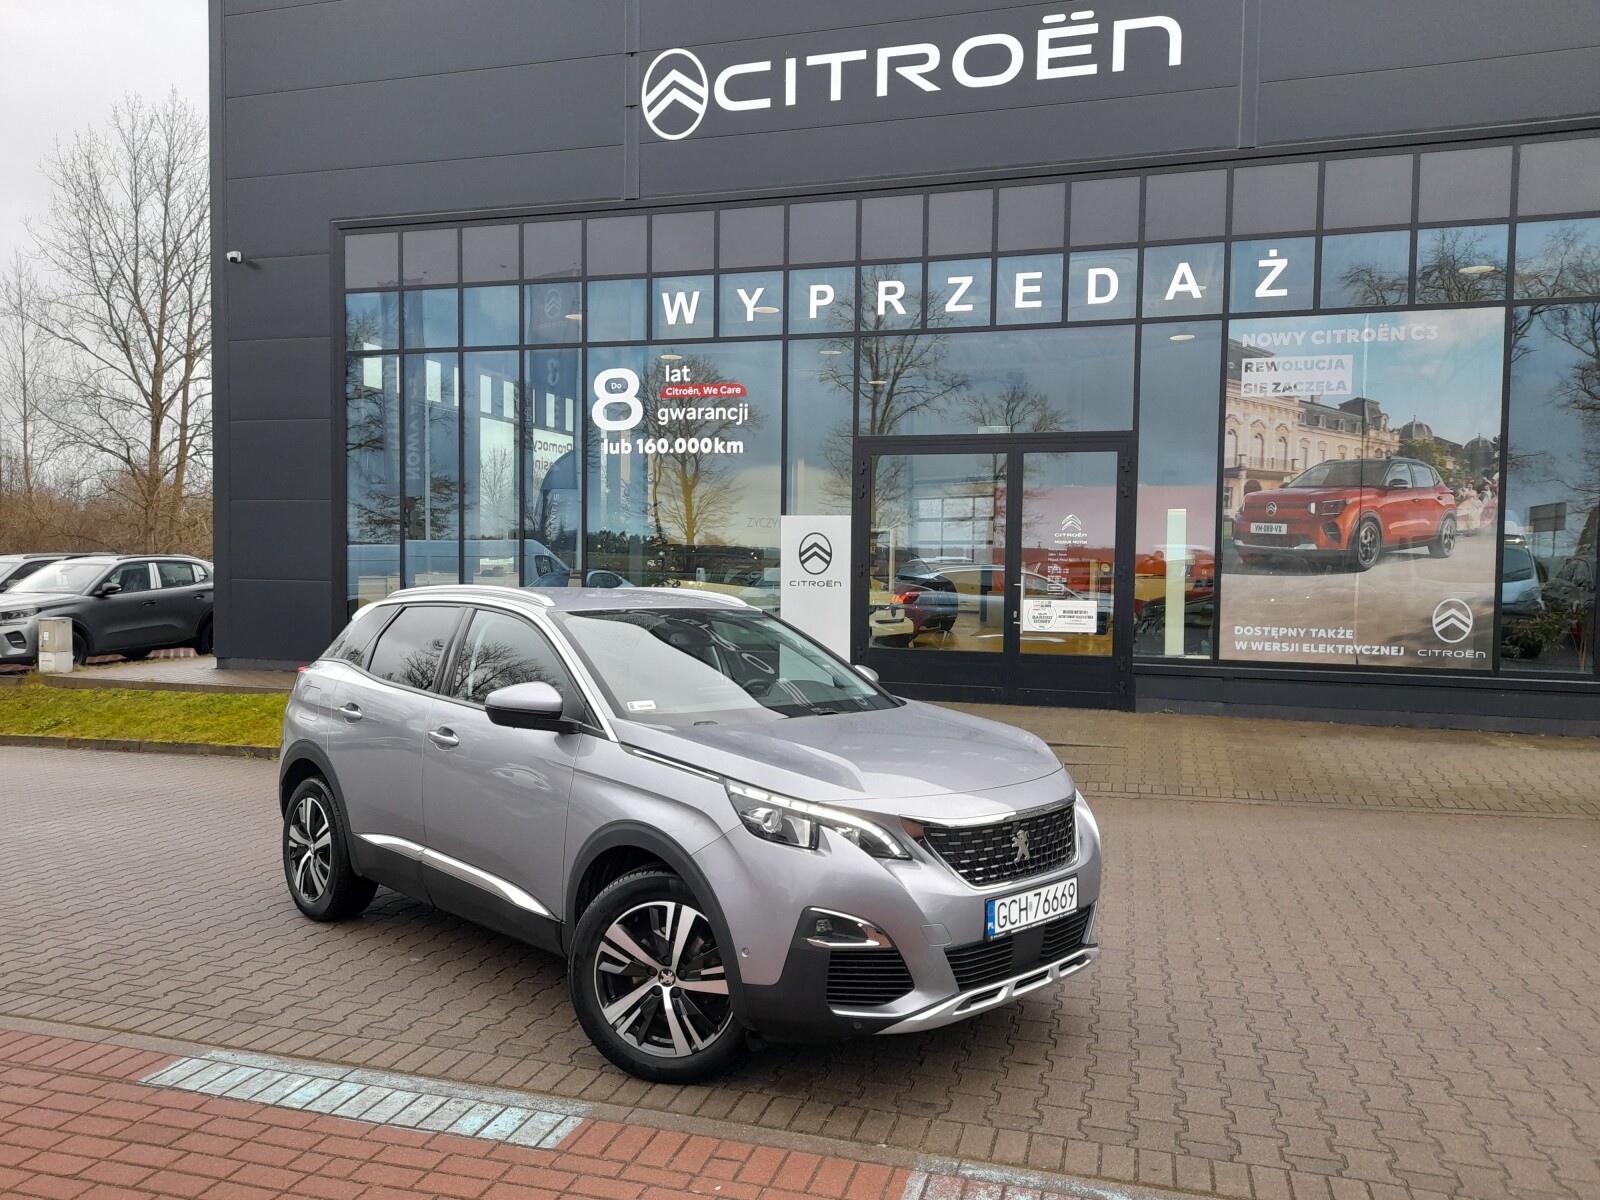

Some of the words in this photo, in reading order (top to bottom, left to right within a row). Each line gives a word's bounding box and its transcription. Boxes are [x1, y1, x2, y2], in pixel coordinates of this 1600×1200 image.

[714, 10, 1182, 111] CITROËN
[1242, 330, 1305, 348] NOWY
[1311, 323, 1405, 345] CITROËN
[1410, 325, 1439, 341] C3
[665, 365, 690, 382] lat
[1244, 359, 1345, 373] REWOLUCJA
[611, 382, 622, 390] Do
[665, 386, 702, 396] Citroën,
[703, 386, 719, 395] We
[720, 386, 741, 395] Care
[591, 368, 644, 431] 8
[657, 403, 749, 426] gwarancji
[602, 438, 632, 455] lub
[789, 579, 842, 588] CITROËN
[1234, 625, 1306, 639] DOSTĘPNY
[1309, 626, 1354, 639] TAKŻE
[1235, 640, 1248, 650] W
[1250, 641, 1300, 653] WERSJI
[1302, 643, 1405, 657] ELEKTRYCZNEJ
[1417, 649, 1486, 659] CITROËN
[997, 896, 1029, 929] GCH
[1033, 882, 1076, 919] 76669
[987, 921, 995, 930] PL
